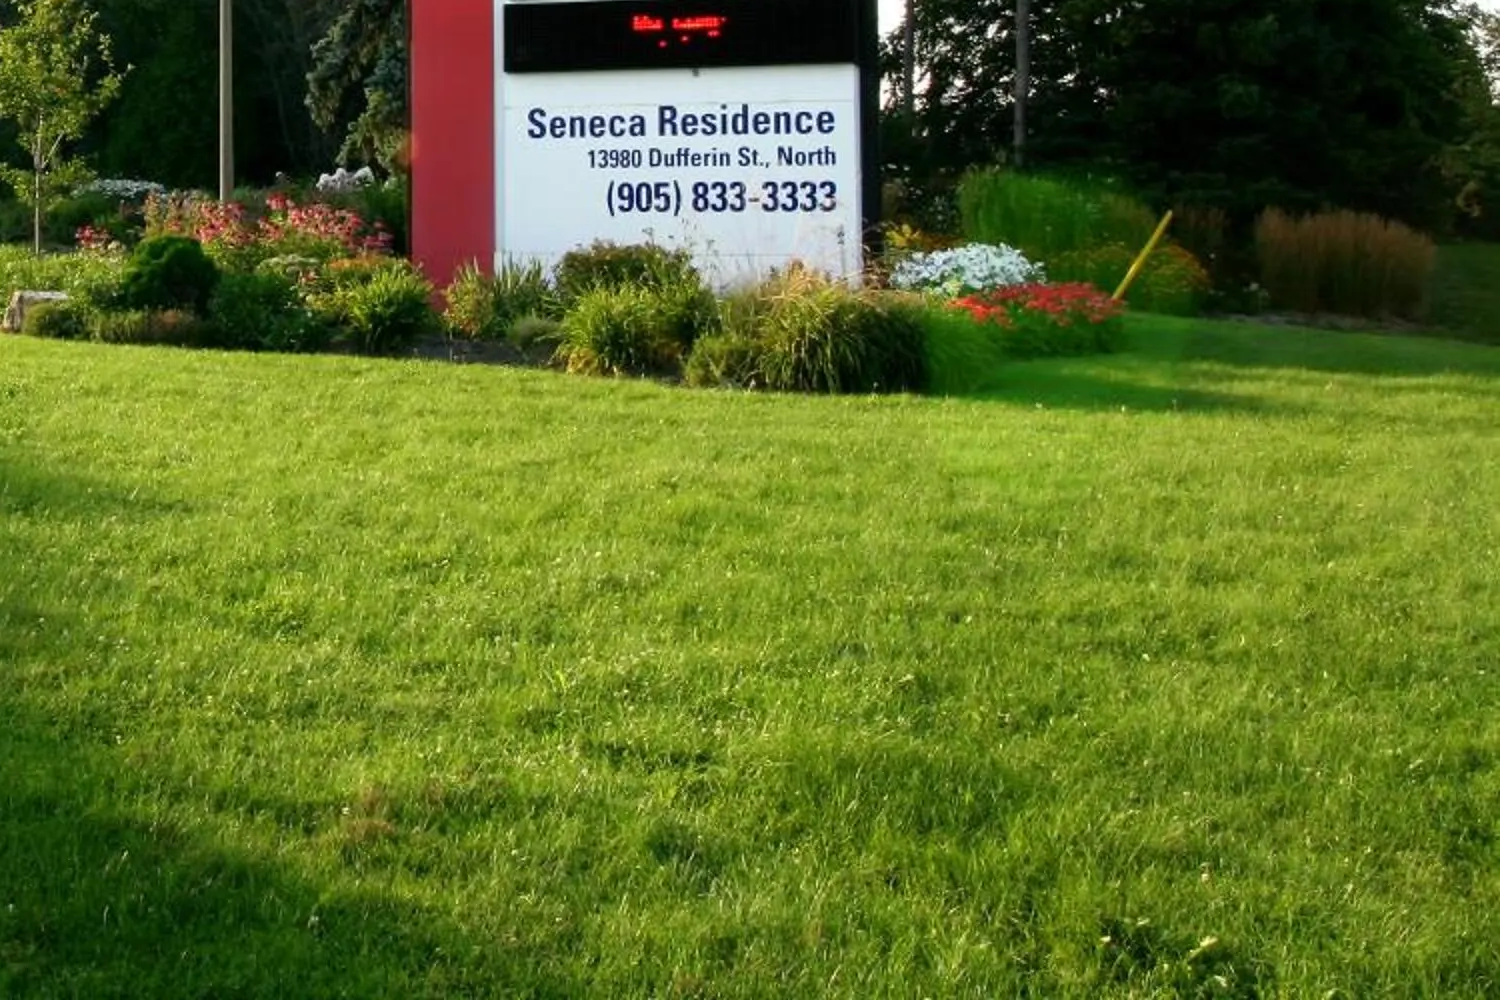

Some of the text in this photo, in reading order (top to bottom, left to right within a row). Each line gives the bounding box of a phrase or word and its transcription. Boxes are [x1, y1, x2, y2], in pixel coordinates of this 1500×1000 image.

[527, 104, 835, 138] Seneca Residence
[587, 146, 837, 169] 13980 Dufferin St., North
[606, 180, 837, 217] (905) 833-3333
